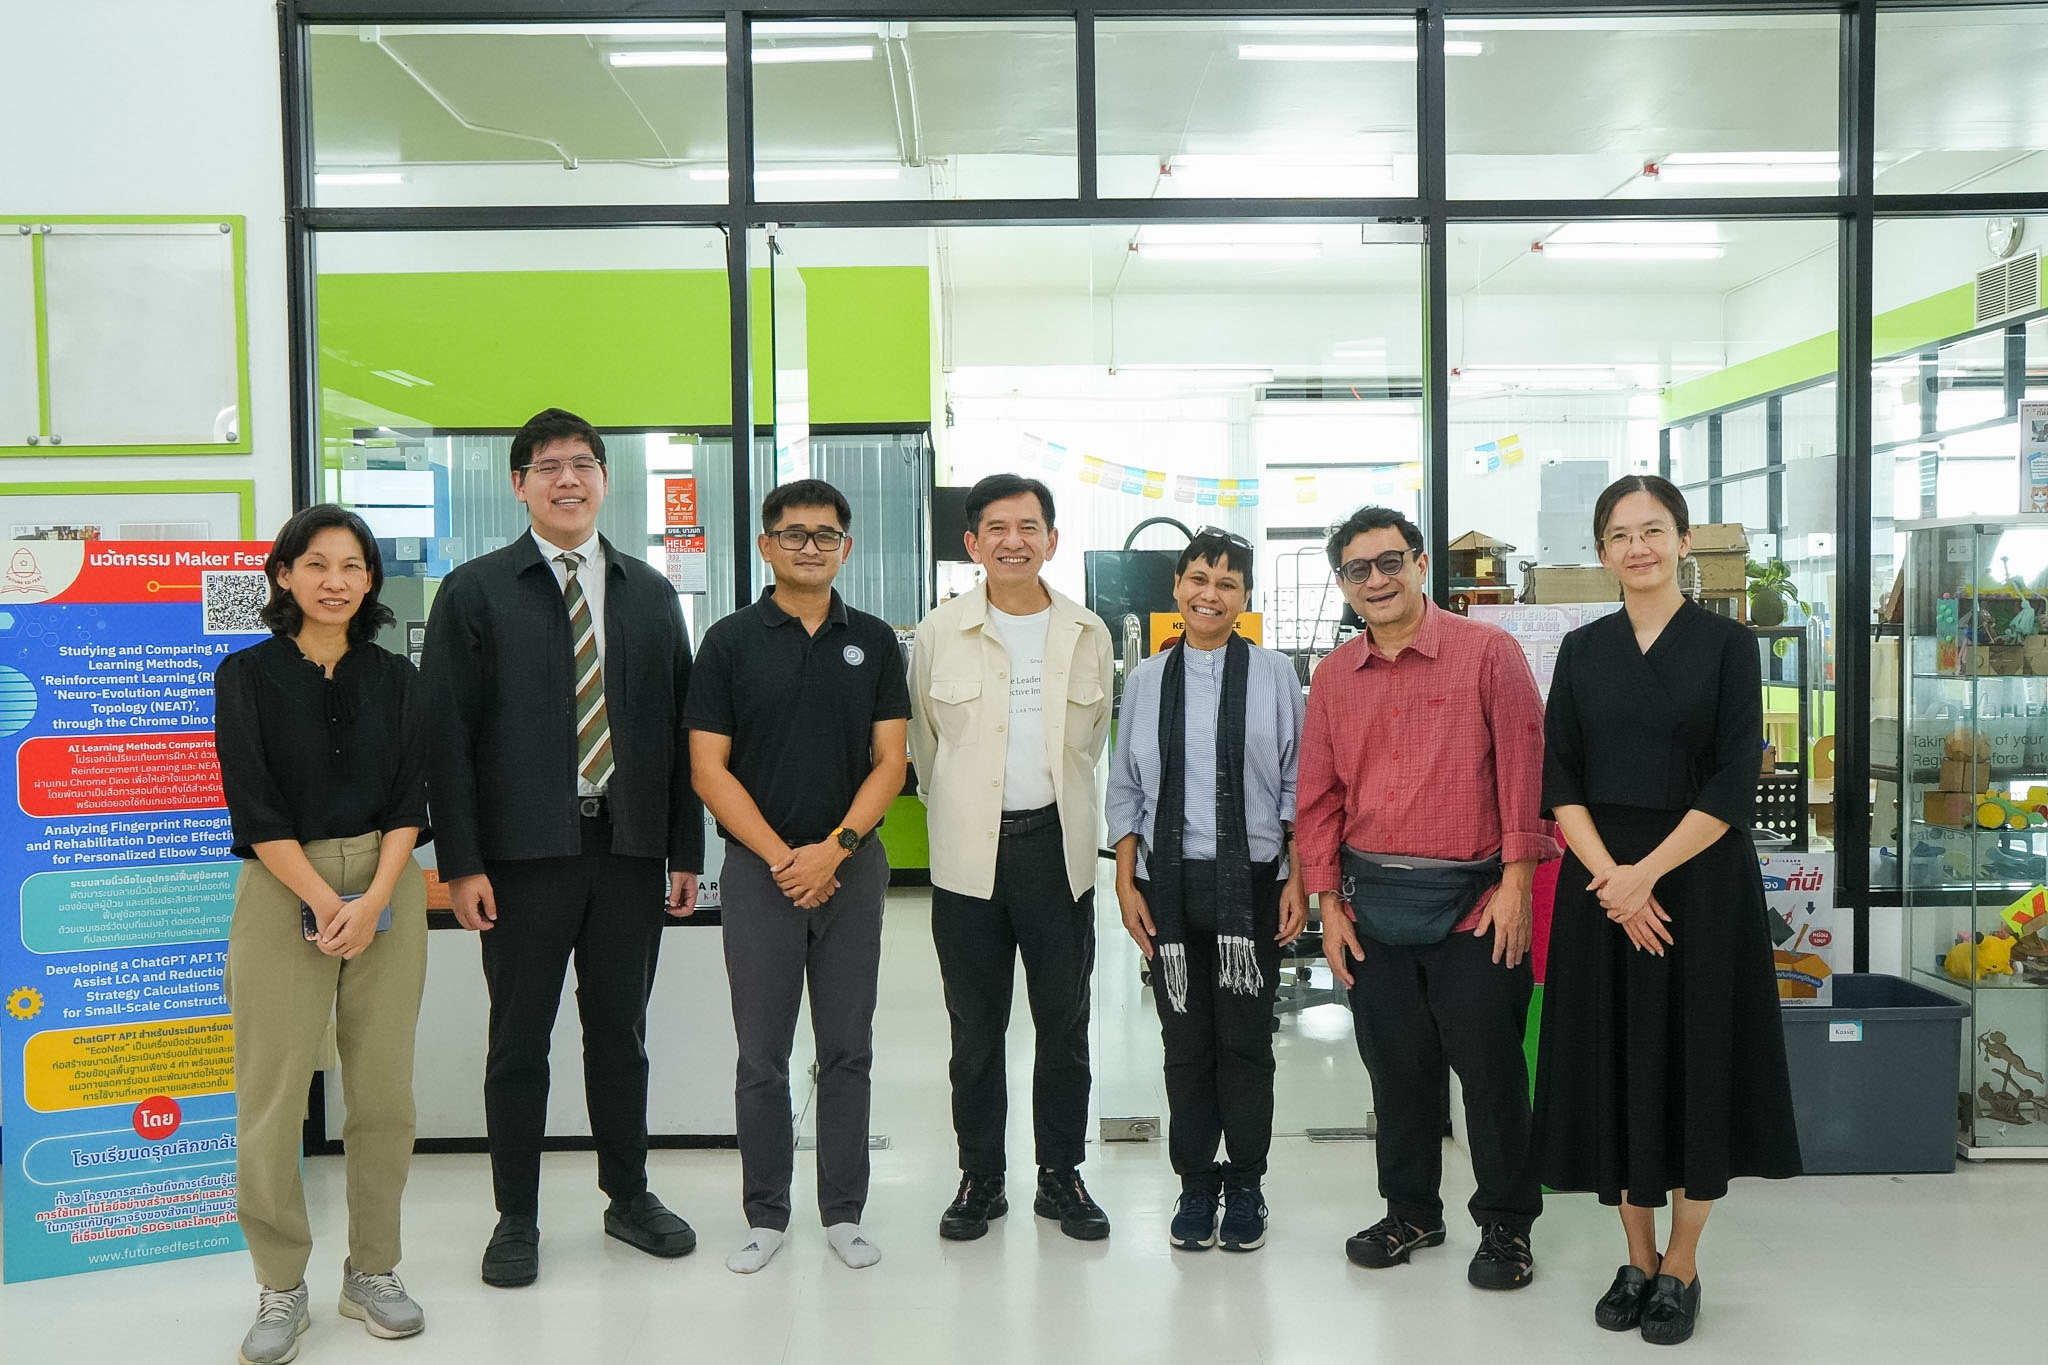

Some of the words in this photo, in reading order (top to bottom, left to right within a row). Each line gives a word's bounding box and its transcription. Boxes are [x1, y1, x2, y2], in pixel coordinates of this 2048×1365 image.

[90, 550, 170, 566] นวัตกรรม
[176, 552, 229, 566] Maker
[234, 552, 269, 566] Fest
[60, 646, 116, 658] Studying
[119, 645, 142, 655] and
[146, 644, 212, 656] Comparing
[215, 644, 229, 653] AI
[89, 659, 143, 671] Learning
[146, 658, 202, 669] Methods,
[142, 673, 195, 684] Learning
[164, 688, 215, 699] Augmen
[91, 702, 147, 715] Topology
[53, 718, 103, 730] through
[106, 718, 126, 727] the
[130, 716, 178, 726] Chrome
[181, 715, 208, 725] Dino
[68, 744, 80, 752] AI
[82, 743, 124, 754] Learning
[126, 742, 167, 751] Methods
[1995, 733, 2008, 745] of
[2013, 735, 2044, 748] your
[200, 750, 217, 759] ด้วย
[71, 766, 138, 775] Reinforcement
[141, 764, 180, 773] Learning
[198, 762, 220, 770] NEAT
[70, 778, 106, 786] Chrome
[44, 823, 108, 836] Analyzing
[111, 819, 180, 833] Fingerprint
[183, 816, 231, 829] Recogni
[26, 840, 51, 851] and
[54, 836, 143, 850] Rehabilitation
[147, 833, 188, 844] Device
[53, 854, 71, 864] for
[75, 849, 156, 863] Personalized
[160, 847, 197, 858] Elbow
[1786, 866, 1823, 891] ที่นี่!
[46, 961, 118, 975] Developing
[121, 961, 128, 969] a
[132, 955, 186, 968] ChatGPT
[190, 953, 212, 964] API
[73, 976, 112, 988] Assist
[116, 974, 139, 984] LCA
[143, 971, 166, 982] and
[87, 989, 140, 1001] Strategy
[144, 982, 220, 996] Calculations
[63, 1008, 81, 1018] for
[85, 1001, 160, 1016] Small-Scale
[73, 1033, 116, 1045] ChatGPT
[118, 1032, 136, 1040] API
[141, 1110, 173, 1128] โดย
[36, 1191, 199, 1220] การใช้เทคโนโลยีอย่างสร้างสรรค์
[56, 1192, 70, 1205] ทั้ง
[73, 1194, 80, 1202] 3
[47, 1206, 196, 1232] ในการแก้ปัญหาจริงของสังคม
[71, 1226, 138, 1242] ที่เชื่อมโยงกับ
[142, 1223, 171, 1233] SDGs
[89, 1237, 229, 1264] www.futureedfest.com
